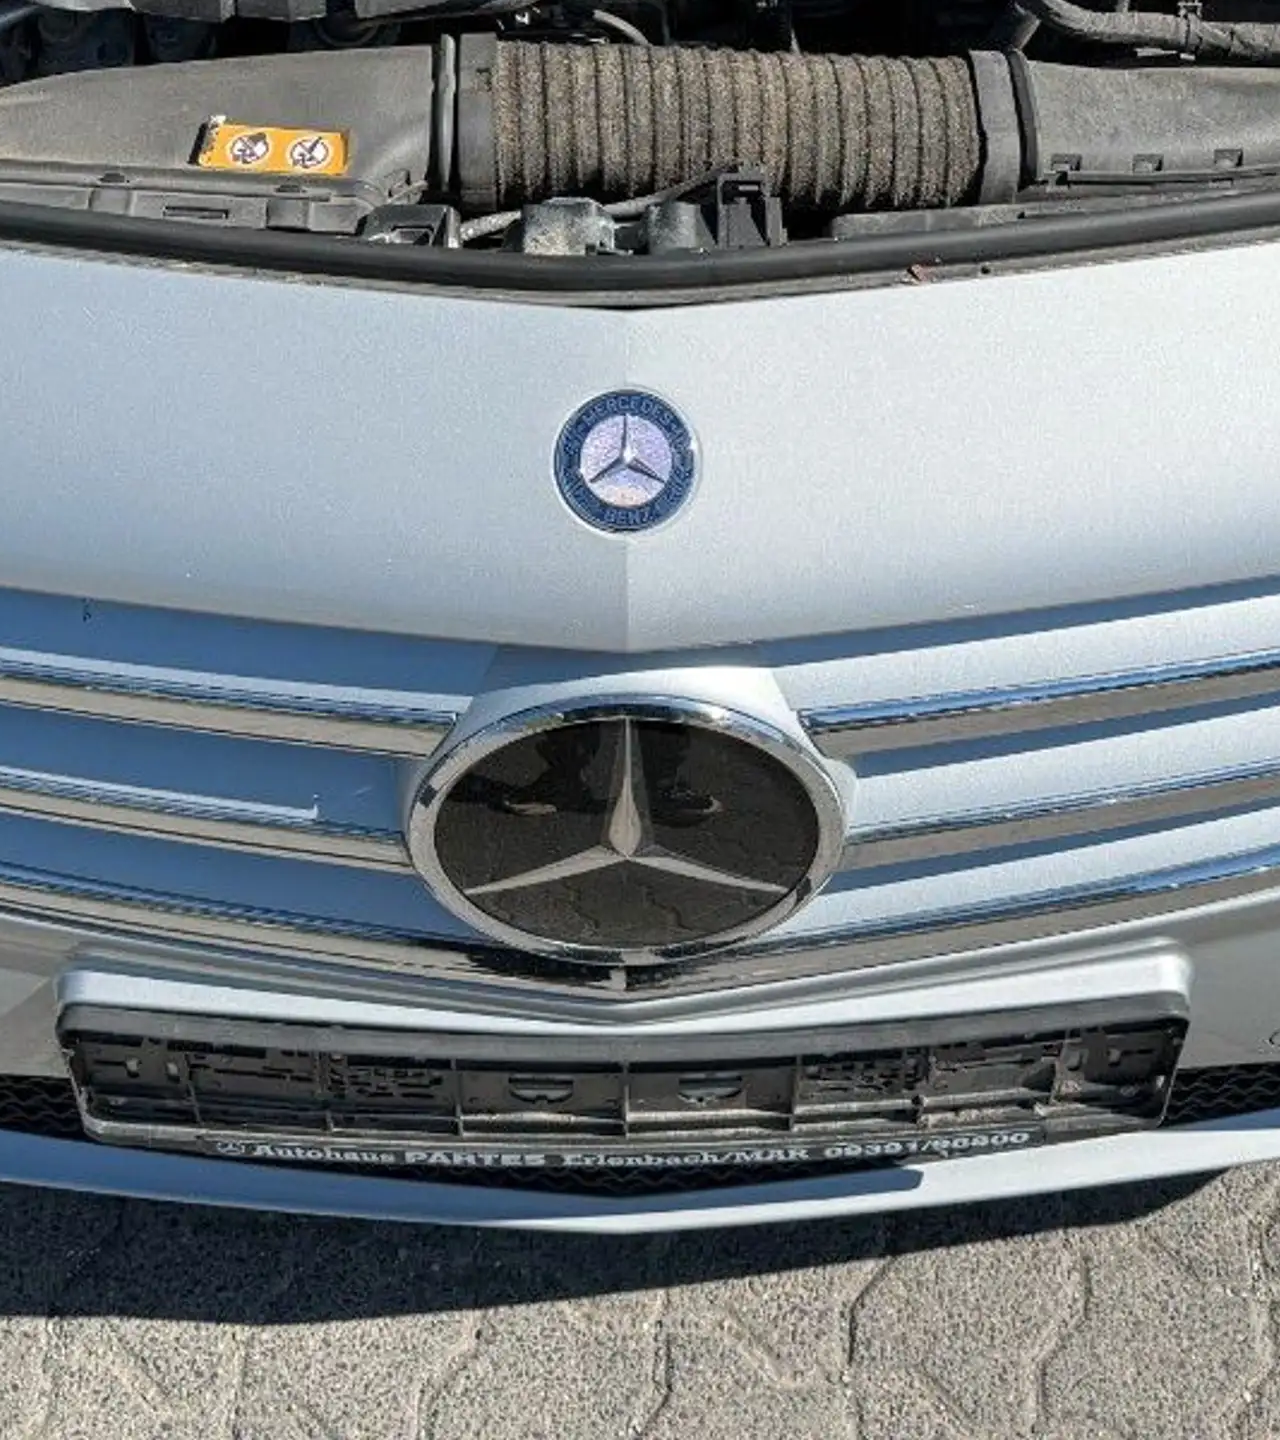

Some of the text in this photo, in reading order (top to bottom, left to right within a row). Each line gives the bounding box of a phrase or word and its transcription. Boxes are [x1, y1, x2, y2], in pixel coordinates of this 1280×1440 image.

[585, 396, 674, 427] MERCEDES
[604, 506, 657, 524] BENZ
[253, 1142, 395, 1162] Autohaus
[405, 1149, 546, 1166] PARTES
